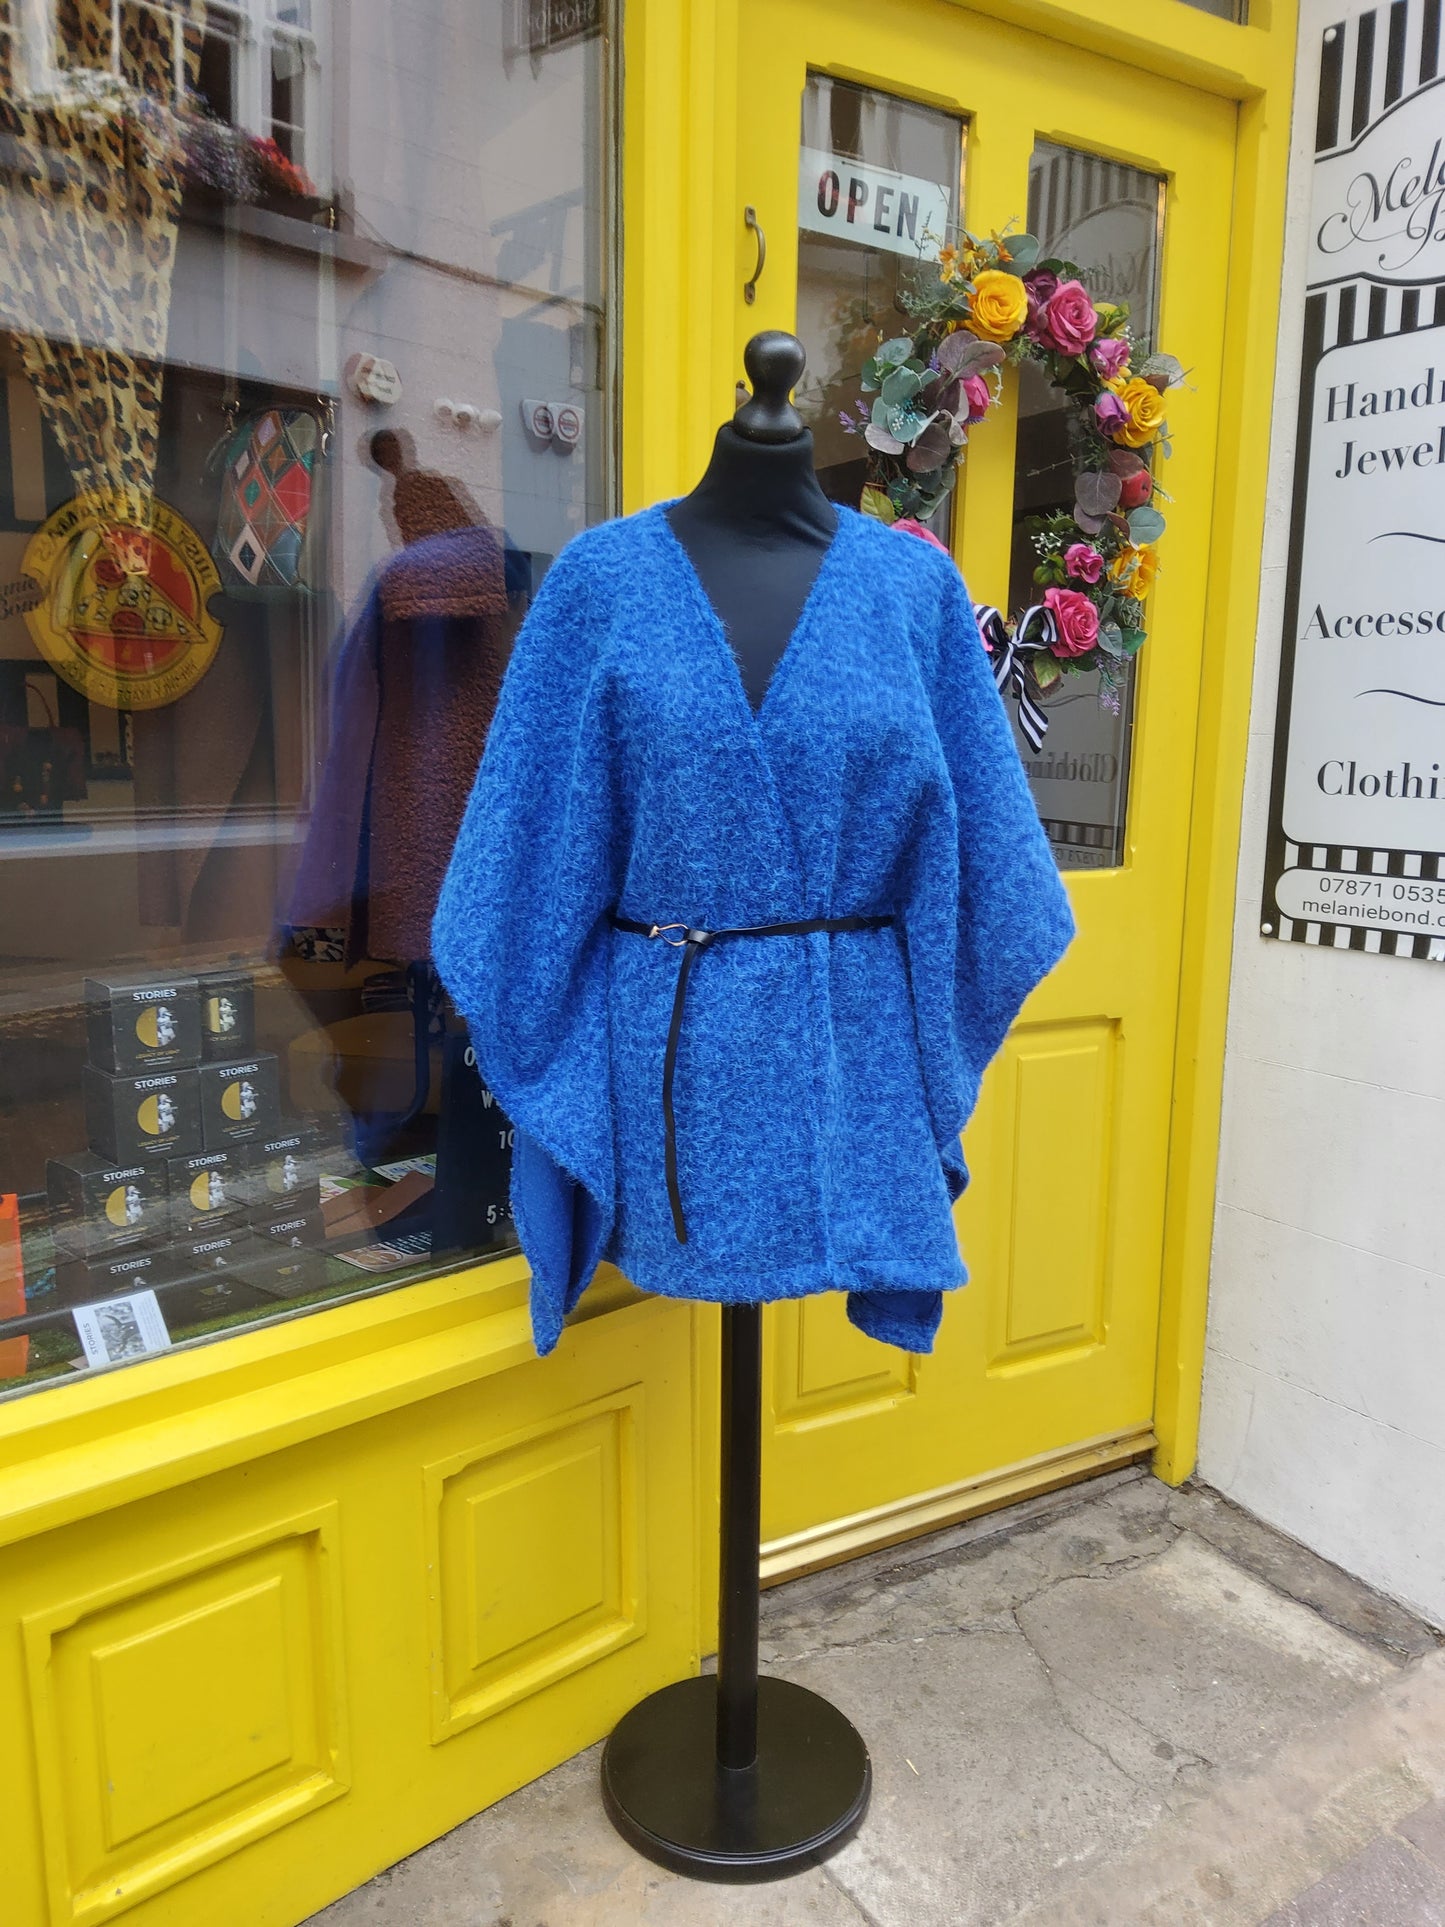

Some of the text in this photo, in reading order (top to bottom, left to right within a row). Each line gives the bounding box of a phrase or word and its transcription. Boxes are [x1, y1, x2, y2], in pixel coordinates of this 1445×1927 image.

[817, 170, 919, 240] OPEN
[1324, 367, 1445, 423] Hand
[1317, 760, 1445, 799] Clothi
[1319, 878, 1445, 904] 07871 0535
[133, 988, 177, 1001] STORIES
[219, 1064, 259, 1078] STORIES
[134, 1075, 177, 1090] STORIES
[264, 1137, 300, 1152] STORIES
[188, 1153, 227, 1169] STORIES
[103, 1167, 145, 1182] STORIES
[270, 1218, 306, 1234] STORIES
[193, 1238, 231, 1255] STORIES
[110, 1257, 152, 1274] STORIES
[83, 1322, 99, 1356] STORIES
